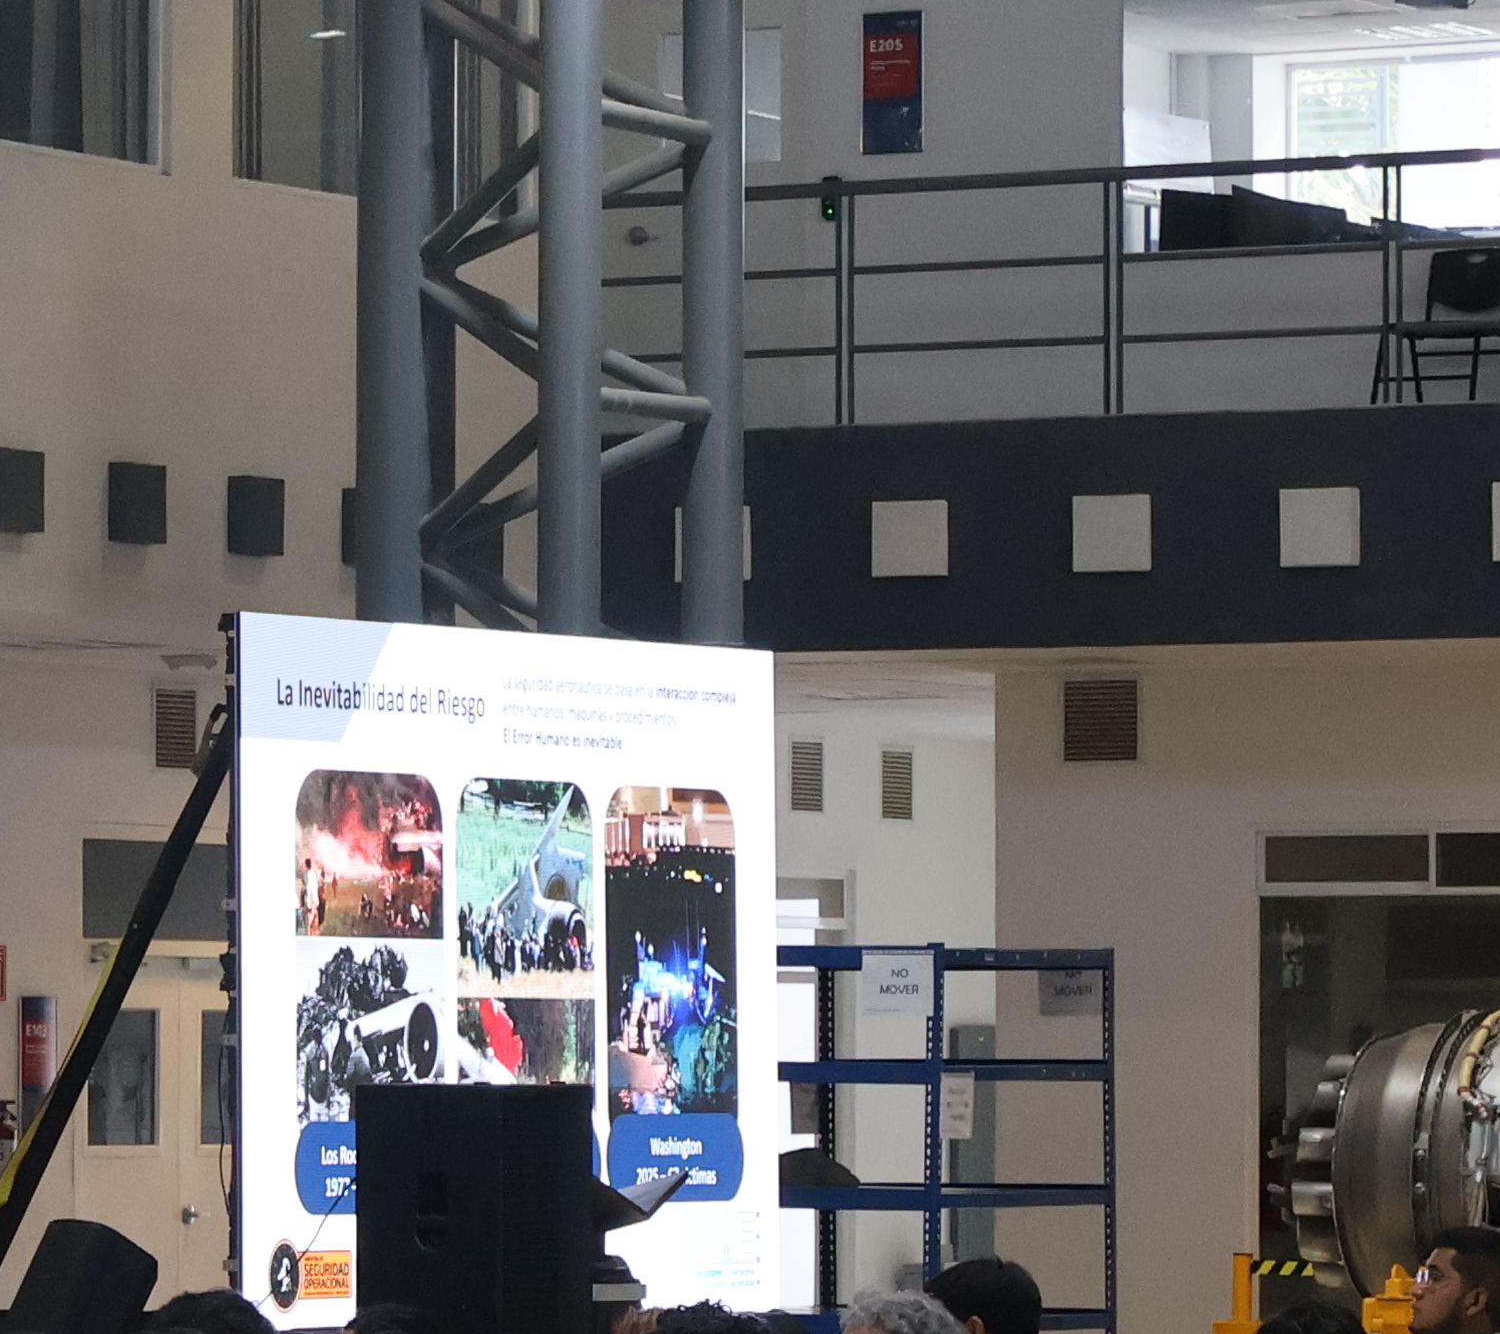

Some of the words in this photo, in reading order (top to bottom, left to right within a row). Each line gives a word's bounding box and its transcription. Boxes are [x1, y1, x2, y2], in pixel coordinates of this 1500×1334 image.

[869, 38, 904, 53] E205
[276, 677, 294, 707] La
[299, 679, 405, 713] Inevitabilidad
[409, 685, 432, 715] del
[437, 688, 485, 725] Riesgo
[656, 684, 700, 701] interacción
[701, 687, 737, 707] compleja
[503, 728, 511, 744] El
[513, 728, 534, 746] Error
[535, 731, 570, 748] Humano
[572, 735, 581, 748] es
[583, 733, 623, 751] inevitable
[890, 968, 909, 979] NO
[879, 984, 920, 996] MOVER
[321, 1145, 339, 1165] Los
[649, 1137, 703, 1160] Washington
[325, 1177, 351, 1197] 1977
[304, 1263, 350, 1277] SEGURIDAD
[304, 1277, 350, 1290] OPERACIONAL
